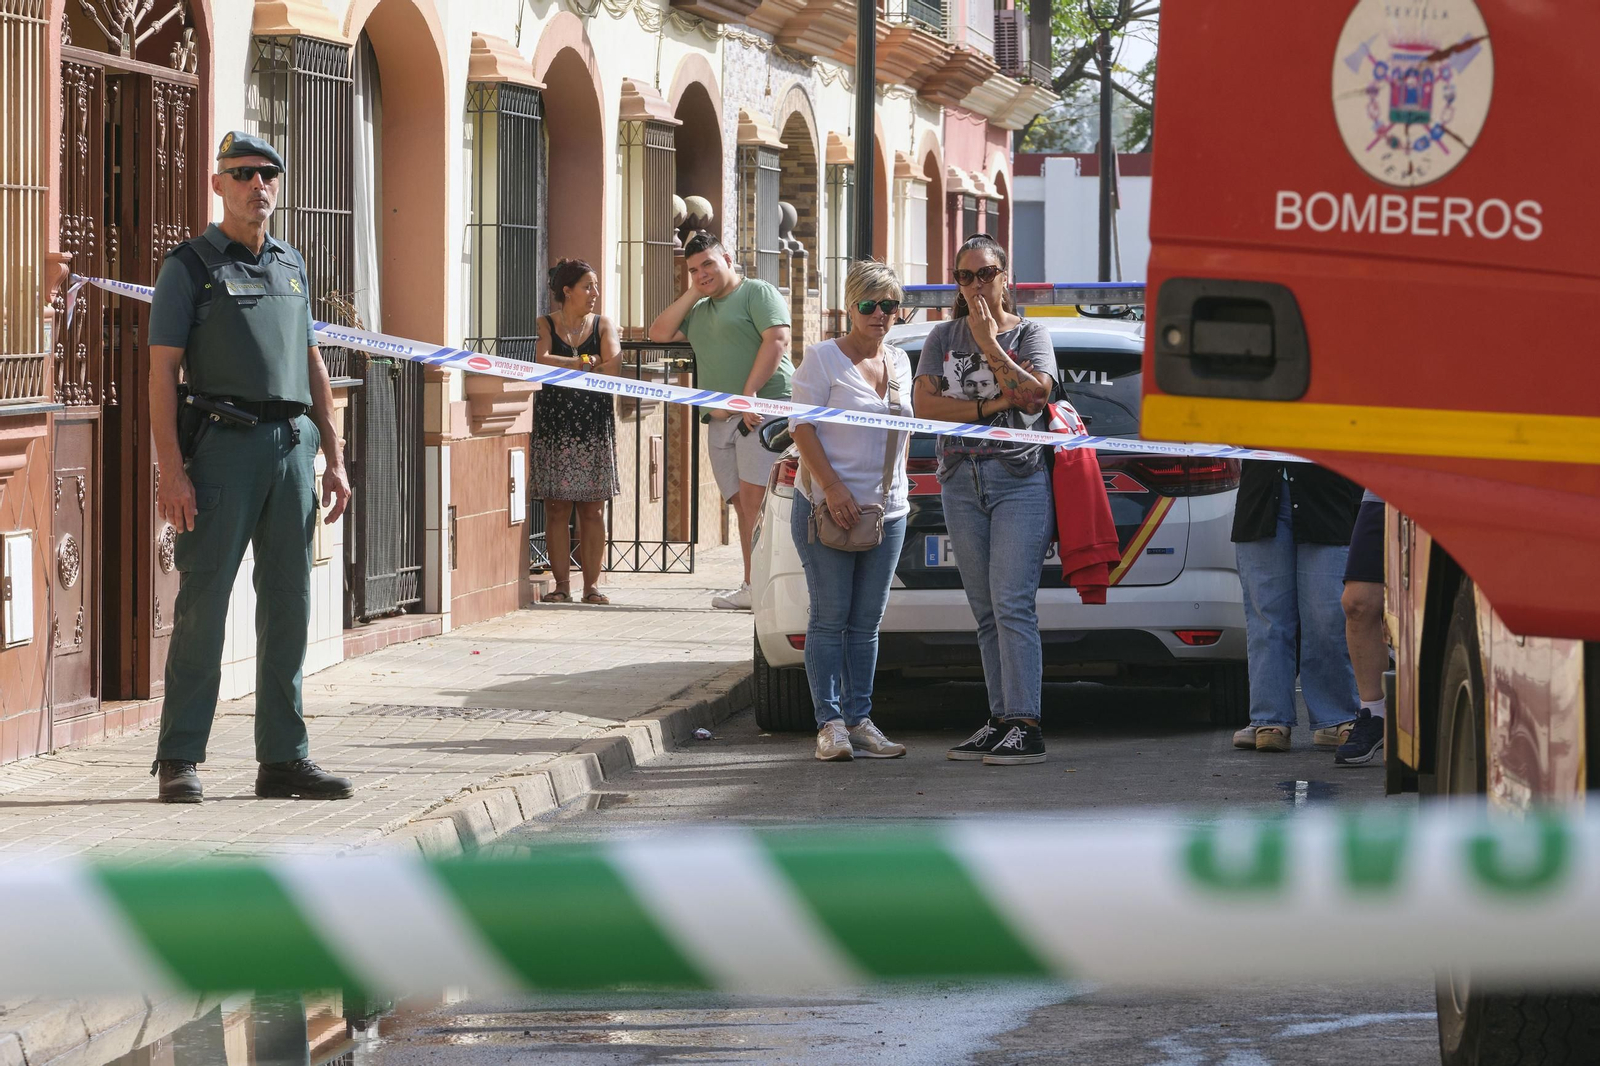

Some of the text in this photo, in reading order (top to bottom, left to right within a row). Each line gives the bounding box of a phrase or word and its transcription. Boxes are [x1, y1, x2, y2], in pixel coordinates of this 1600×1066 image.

[1275, 190, 1543, 241] BOMBEROS
[326, 331, 413, 354] POLICIA LOCAL
[1058, 369, 1114, 386] IVIL
[584, 377, 672, 399] POLICIA LOCAL
[844, 414, 932, 430] POLICIA LOCAL
[929, 553, 936, 561] E
